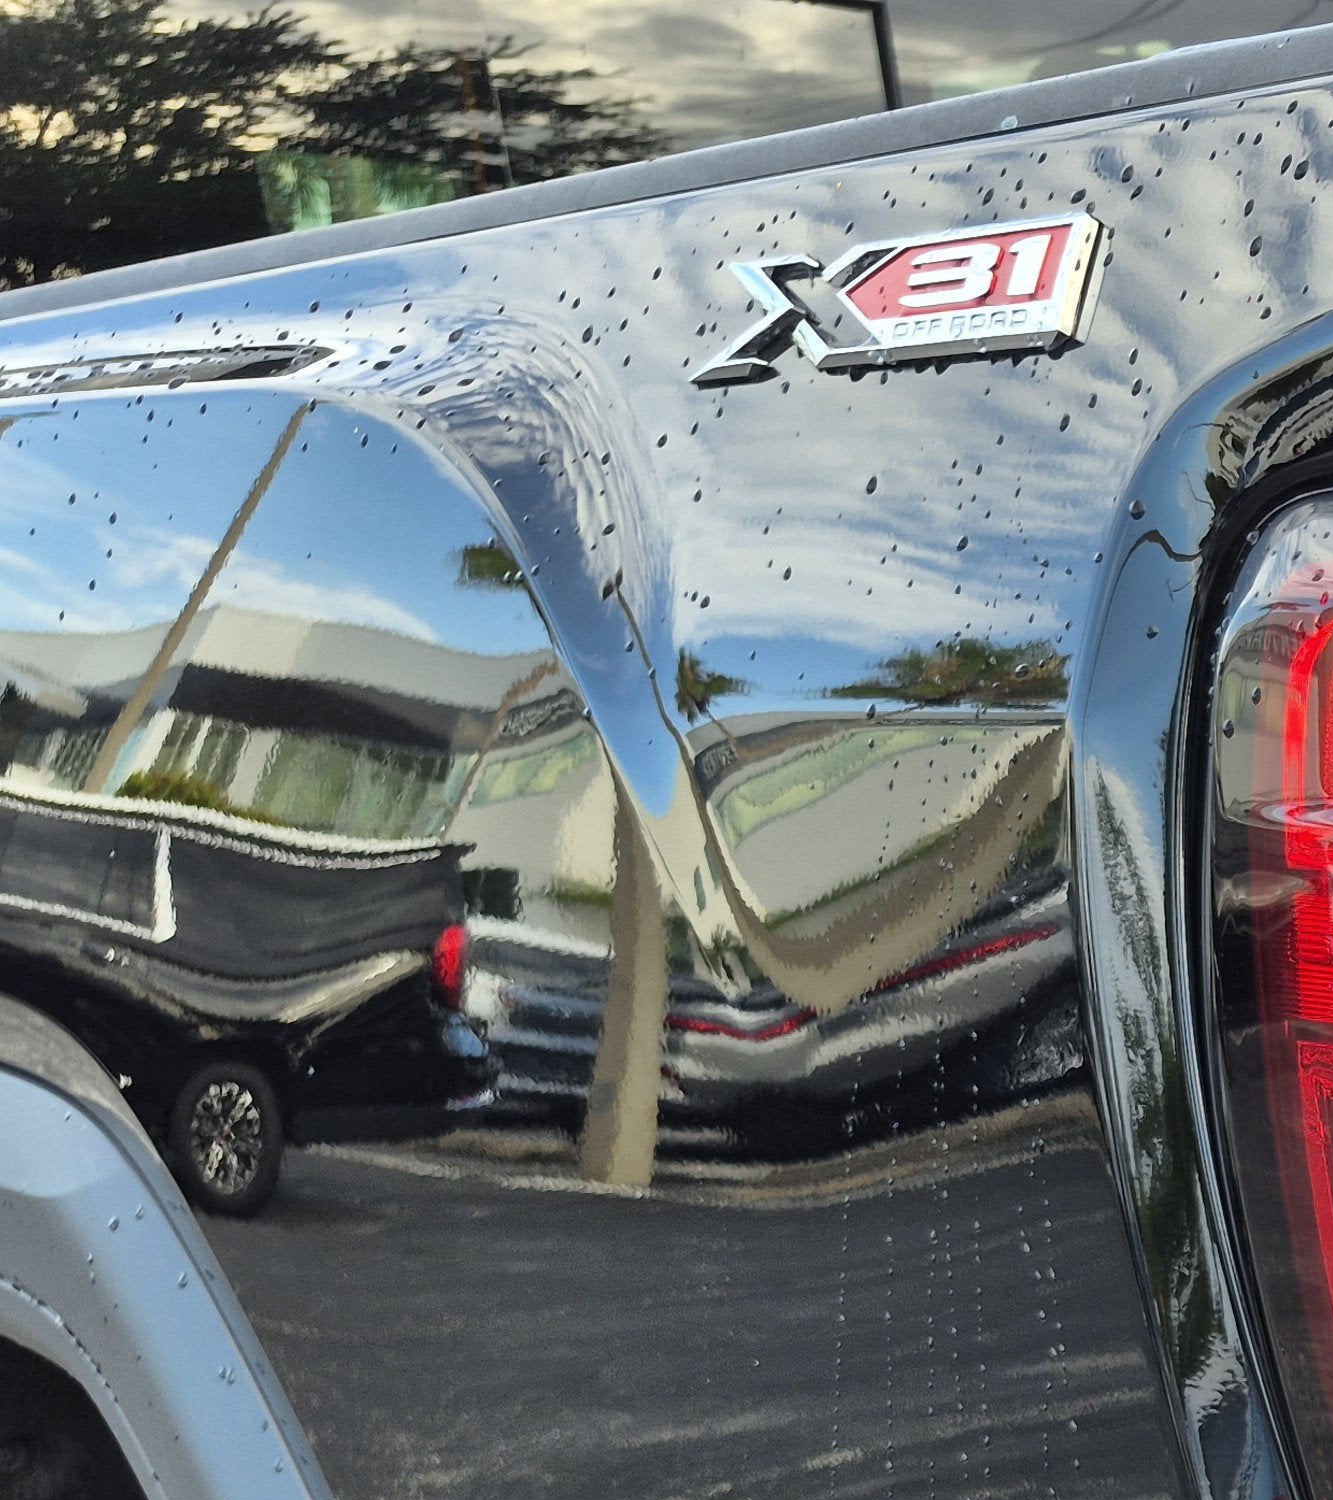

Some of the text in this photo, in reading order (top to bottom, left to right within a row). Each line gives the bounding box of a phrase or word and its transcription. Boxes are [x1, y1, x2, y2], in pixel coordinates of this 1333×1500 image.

[689, 210, 1105, 384] X31
[892, 308, 1028, 341] OFF ROAD
